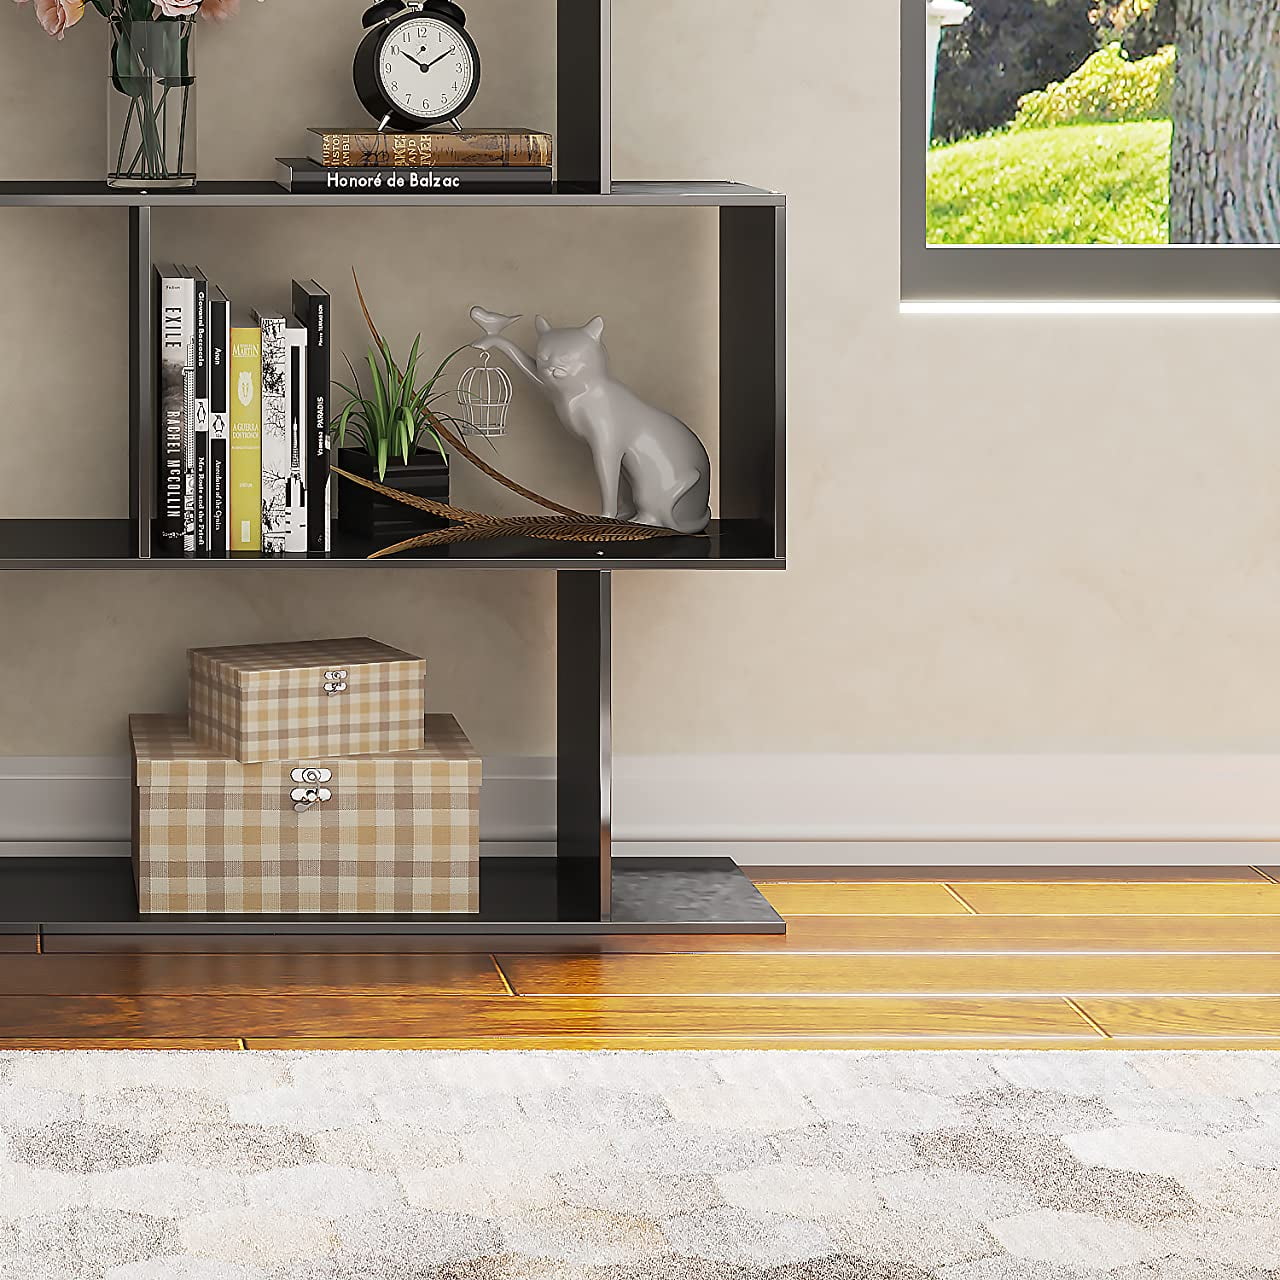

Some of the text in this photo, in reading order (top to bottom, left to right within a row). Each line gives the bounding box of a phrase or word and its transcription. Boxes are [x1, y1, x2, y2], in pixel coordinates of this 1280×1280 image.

[402, 32, 411, 42] 11
[417, 27, 427, 38] 12
[390, 45, 400, 55] 10
[449, 45, 456, 56] 2
[385, 63, 392, 73] 9
[455, 63, 462, 73] 3
[391, 81, 398, 92] 8
[451, 81, 458, 91] 4
[405, 94, 412, 104] 7
[422, 99, 430, 109] 6
[441, 94, 448, 104] 5
[407, 139, 418, 163] AND
[327, 171, 460, 188] Honoré de Balzac
[165, 307, 182, 348] EXILE
[214, 347, 222, 365] Anon
[316, 396, 325, 429] PARADIS
[166, 411, 181, 454] RACHEL
